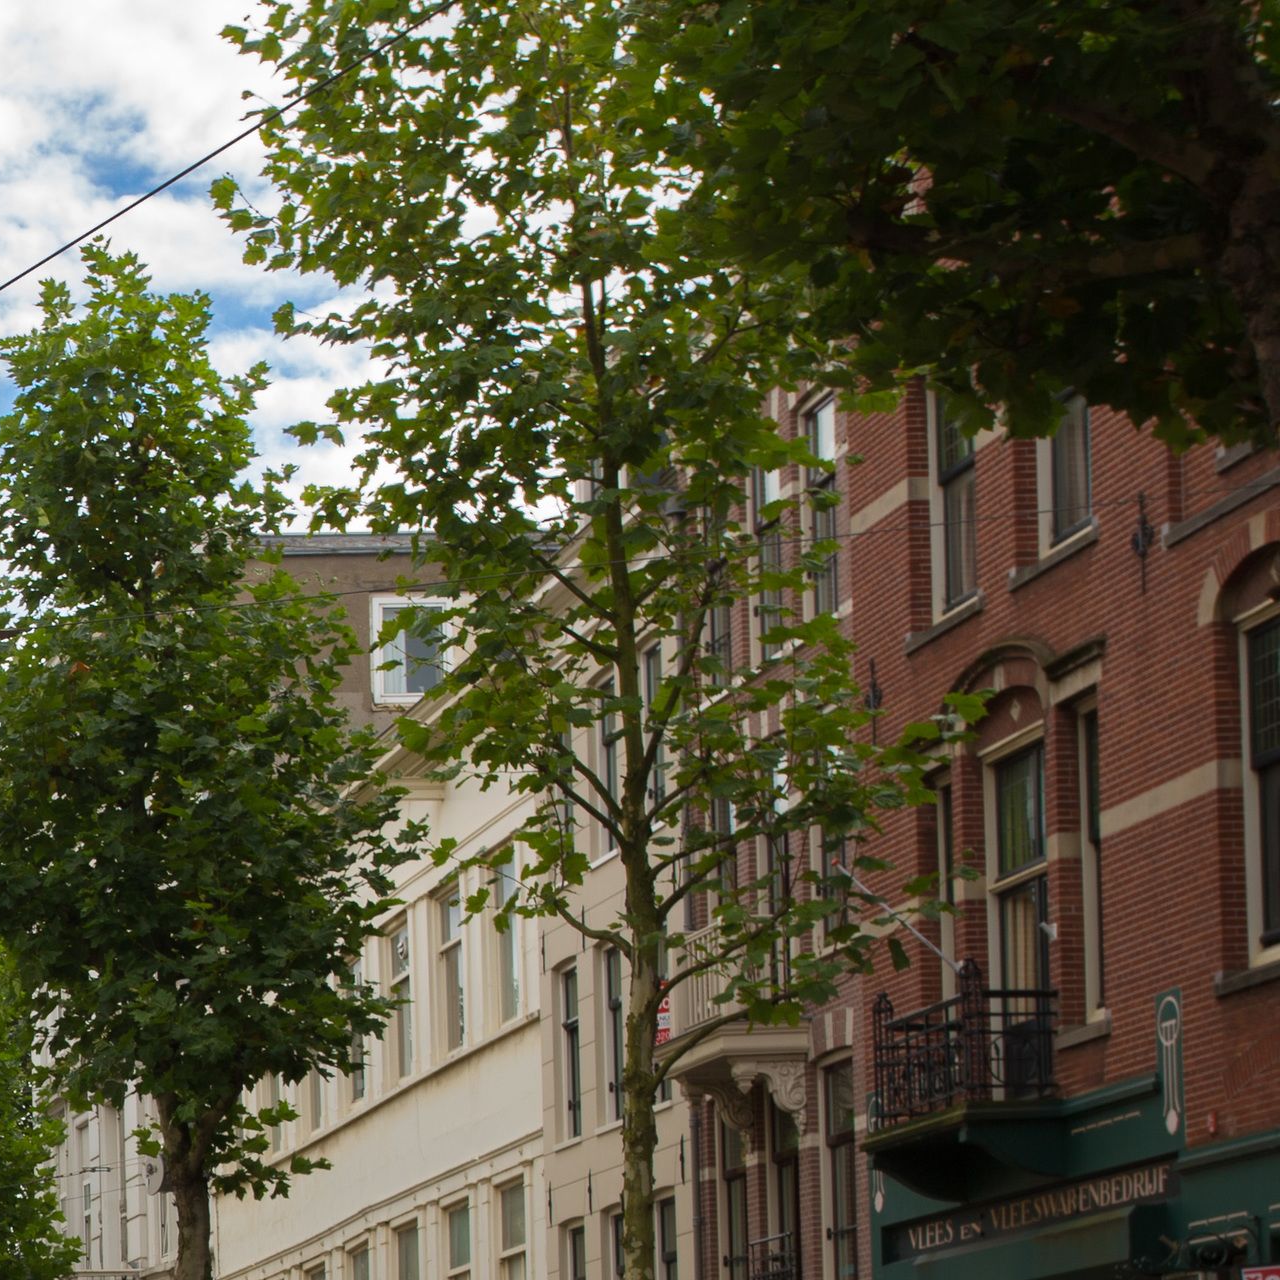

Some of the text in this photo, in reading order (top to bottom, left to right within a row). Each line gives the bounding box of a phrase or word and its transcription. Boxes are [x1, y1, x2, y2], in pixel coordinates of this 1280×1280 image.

[908, 1164, 1171, 1250] VLEES EN VLEESWARENBEDRIJF
